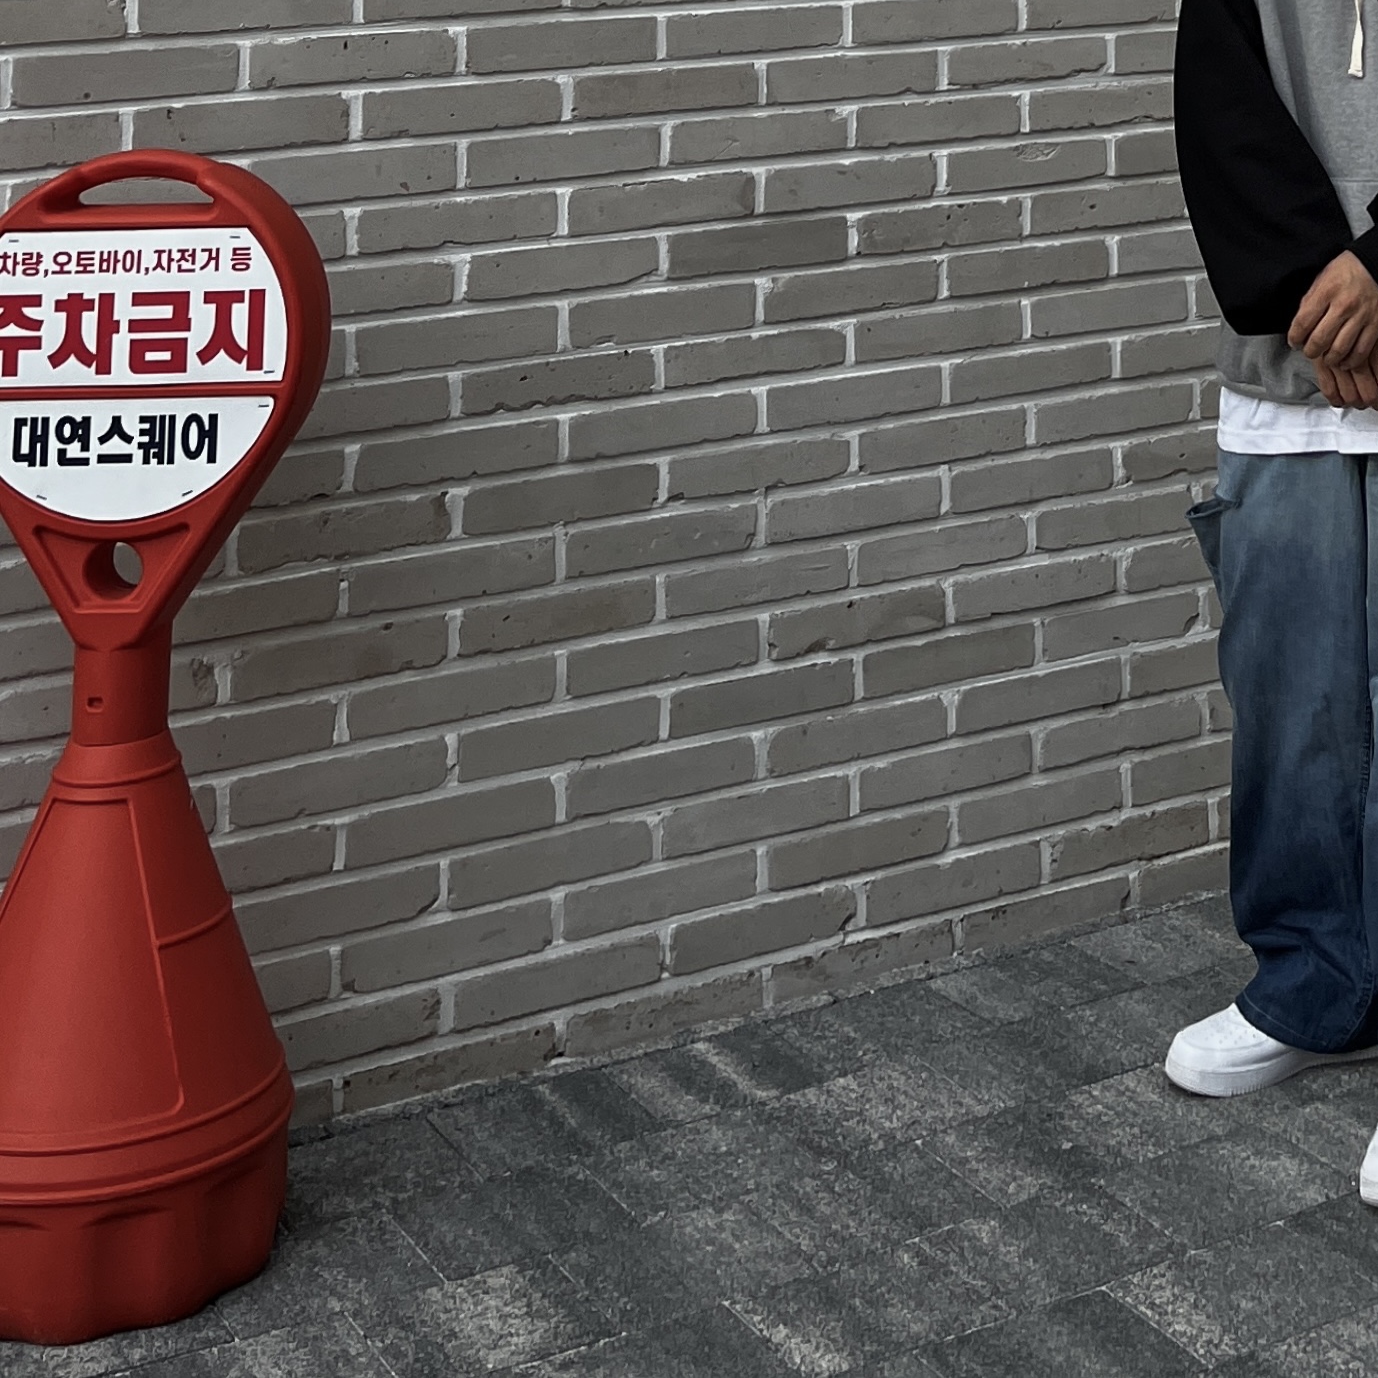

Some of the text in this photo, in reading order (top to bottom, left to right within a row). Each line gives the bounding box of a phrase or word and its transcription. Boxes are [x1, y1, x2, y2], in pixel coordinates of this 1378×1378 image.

[0, 246, 252, 278] 차량,오토바이,자전거 등
[0, 288, 266, 377] 주차금지
[12, 413, 219, 468] 대연스퀘어
